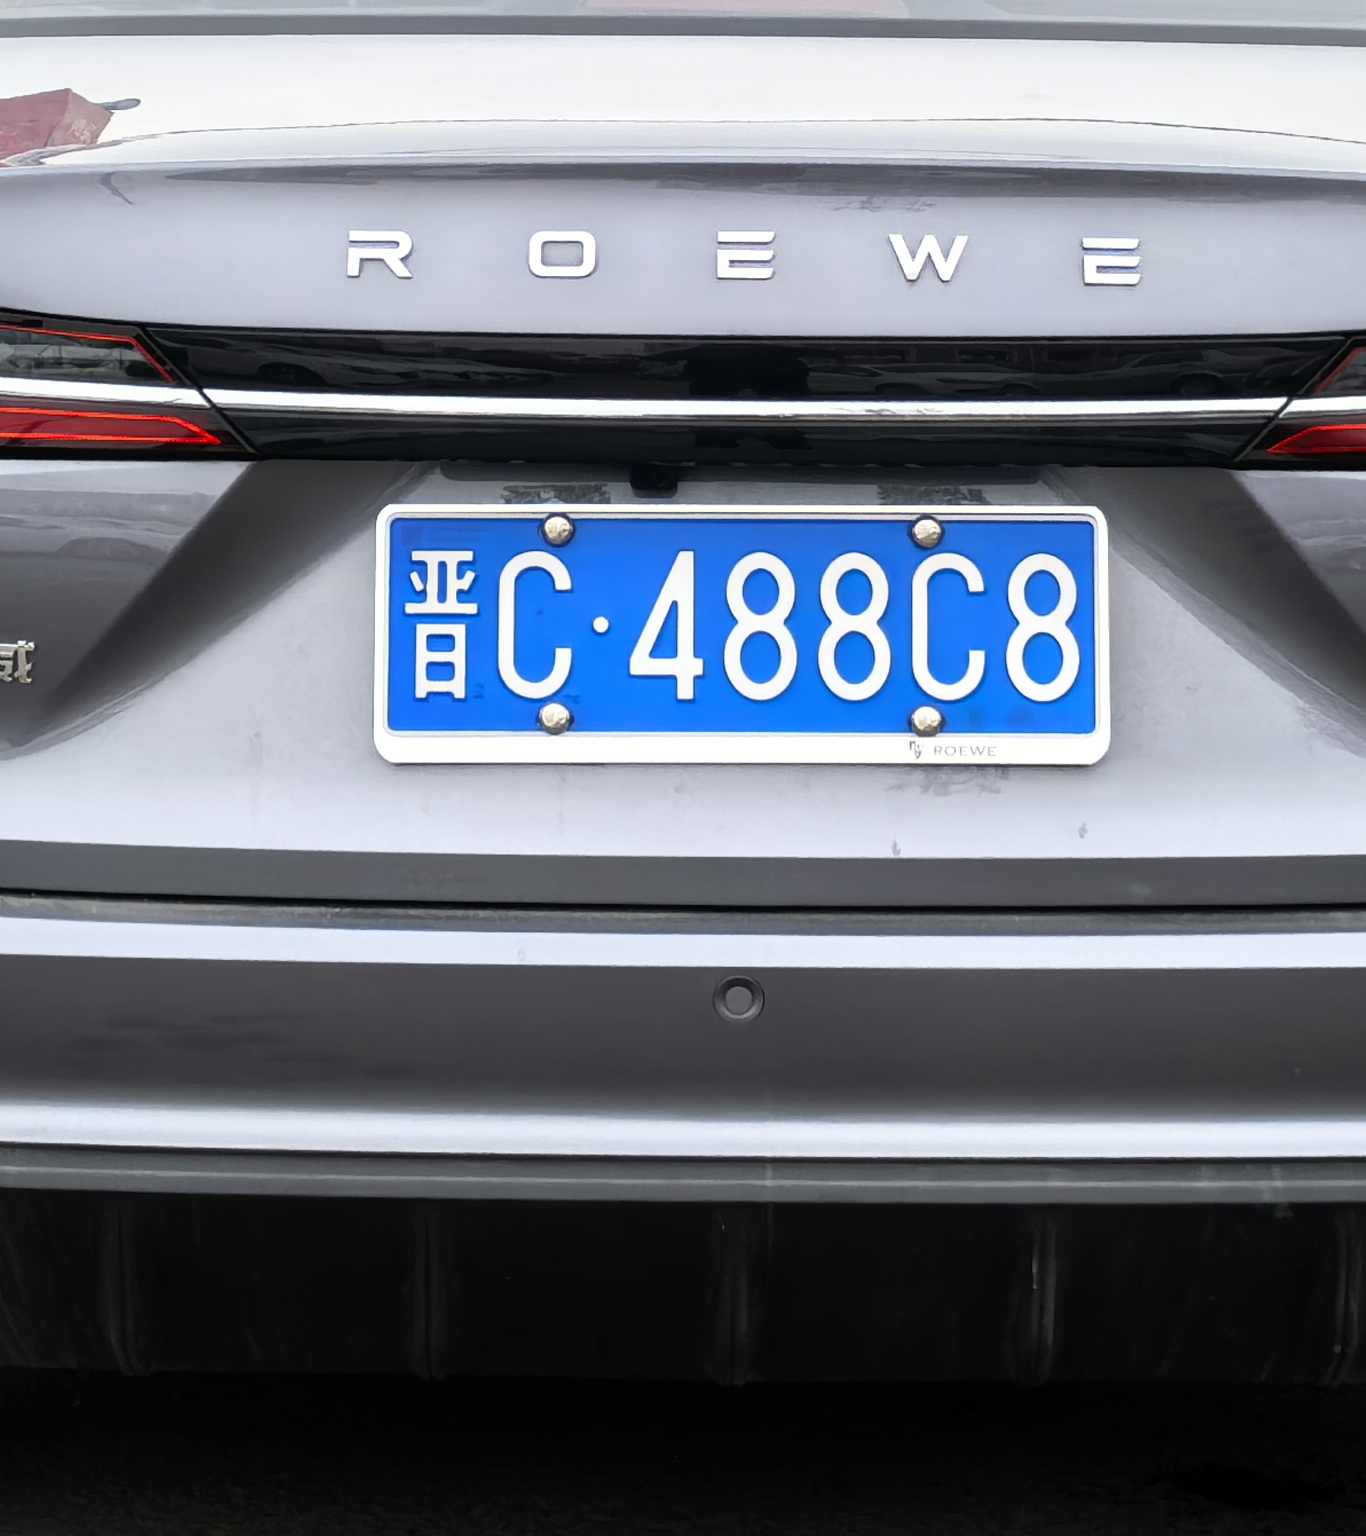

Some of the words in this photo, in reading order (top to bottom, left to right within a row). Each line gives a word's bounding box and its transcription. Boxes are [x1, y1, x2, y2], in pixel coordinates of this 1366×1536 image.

[346, 229, 1142, 286] ROEWE
[404, 549, 1081, 703] 晋C·488C8
[933, 745, 998, 757] ROEWE
